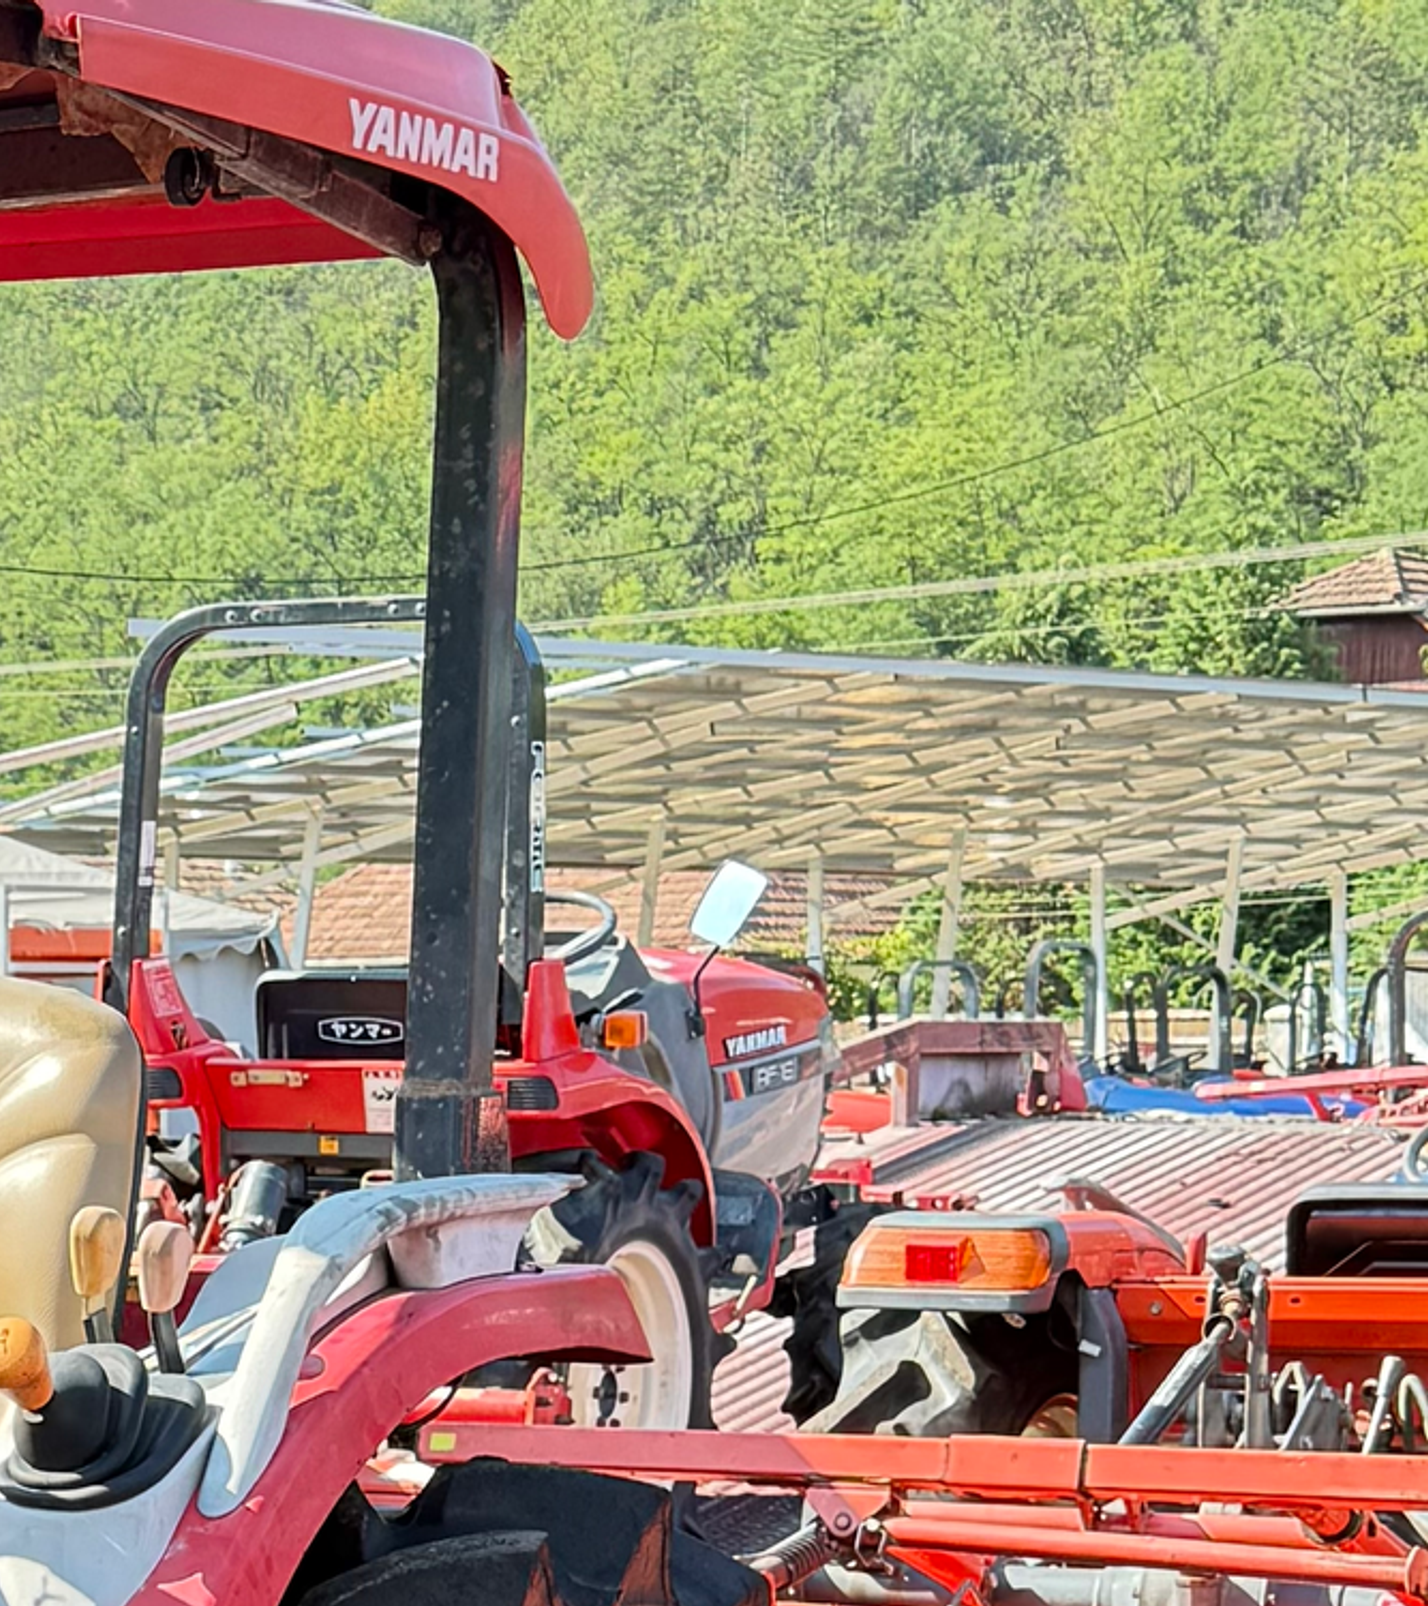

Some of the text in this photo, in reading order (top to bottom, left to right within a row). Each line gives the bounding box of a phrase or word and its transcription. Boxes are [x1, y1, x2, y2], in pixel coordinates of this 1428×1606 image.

[349, 98, 499, 183] YANMAR
[330, 1020, 393, 1039] ヤンマー
[724, 1024, 787, 1057] YANMAR
